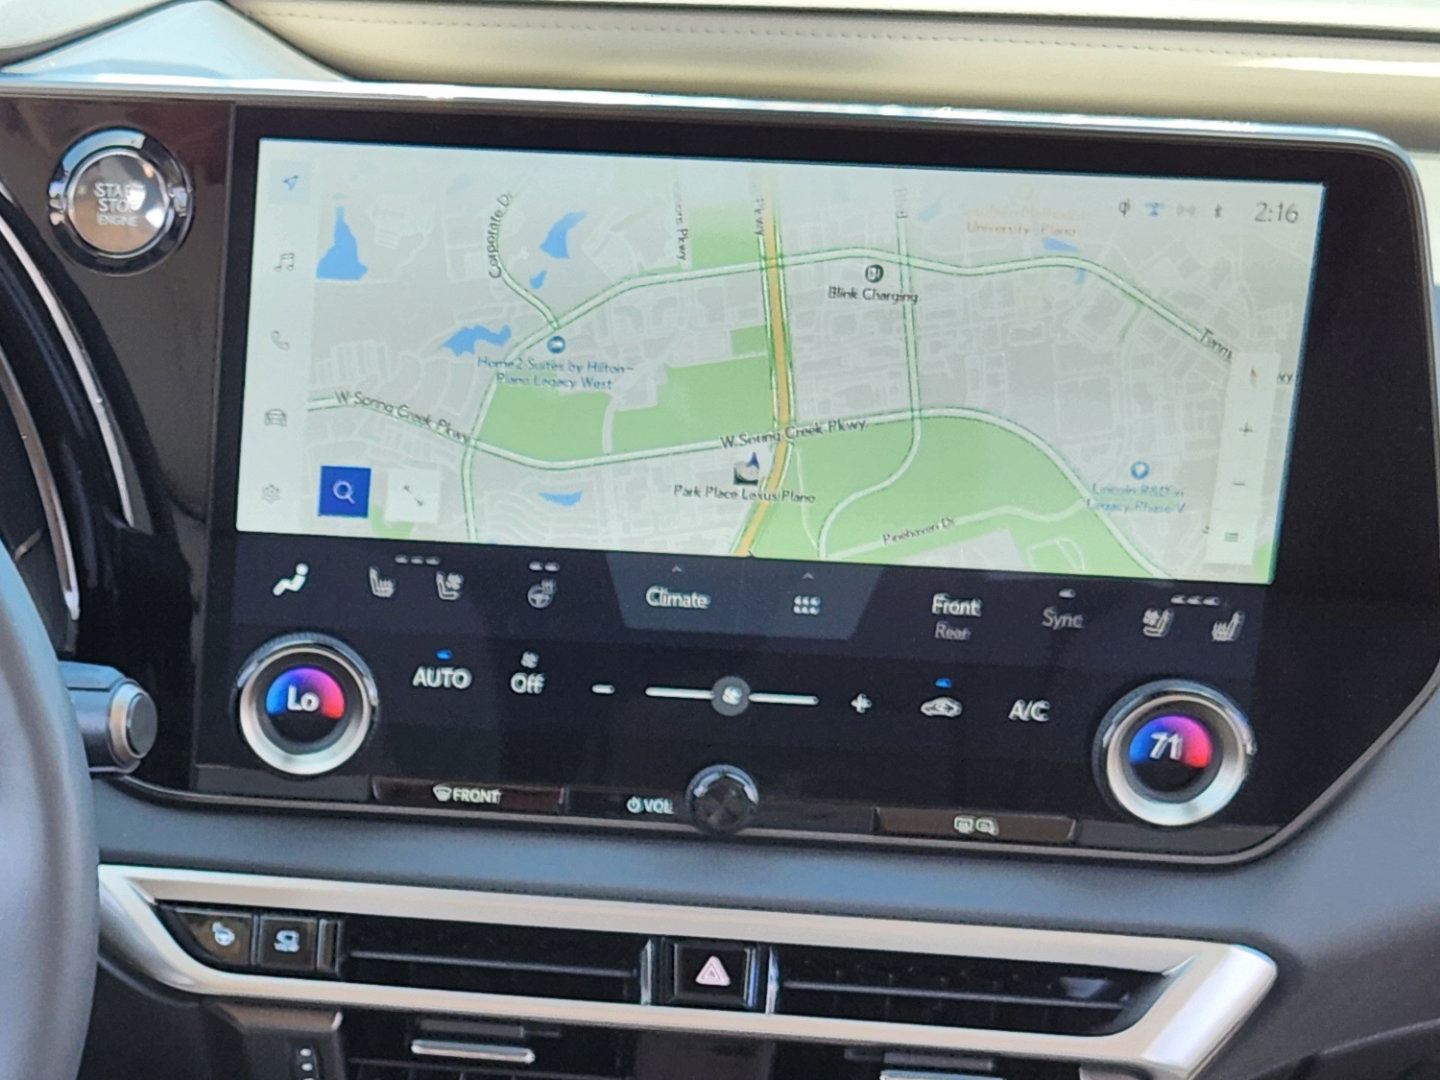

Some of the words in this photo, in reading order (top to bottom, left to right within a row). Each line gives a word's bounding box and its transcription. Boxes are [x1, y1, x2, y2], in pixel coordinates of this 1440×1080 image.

[98, 198, 141, 212] STO
[1254, 202, 1299, 223] 2:16
[487, 208, 503, 279] Corporate
[828, 286, 858, 300] Blink
[862, 288, 919, 305] Charging
[569, 359, 583, 375] by
[582, 376, 613, 389] West
[335, 390, 349, 403] W
[785, 424, 823, 439] Creek
[828, 419, 866, 432] Pkwy
[674, 484, 701, 497] Park
[705, 486, 738, 499] Place
[742, 488, 777, 500] Lexus
[782, 490, 816, 503] Plano
[645, 585, 710, 610] Climate
[931, 593, 982, 616] Front
[1042, 607, 1084, 630] Sync
[934, 622, 971, 641] Rear
[412, 666, 472, 691] AUTO
[510, 672, 545, 695] Off
[287, 685, 320, 713] Lo
[1008, 699, 1051, 722] A/C
[1149, 731, 1183, 761] 71
[453, 787, 501, 806] FRONT
[643, 798, 674, 815] VOL
